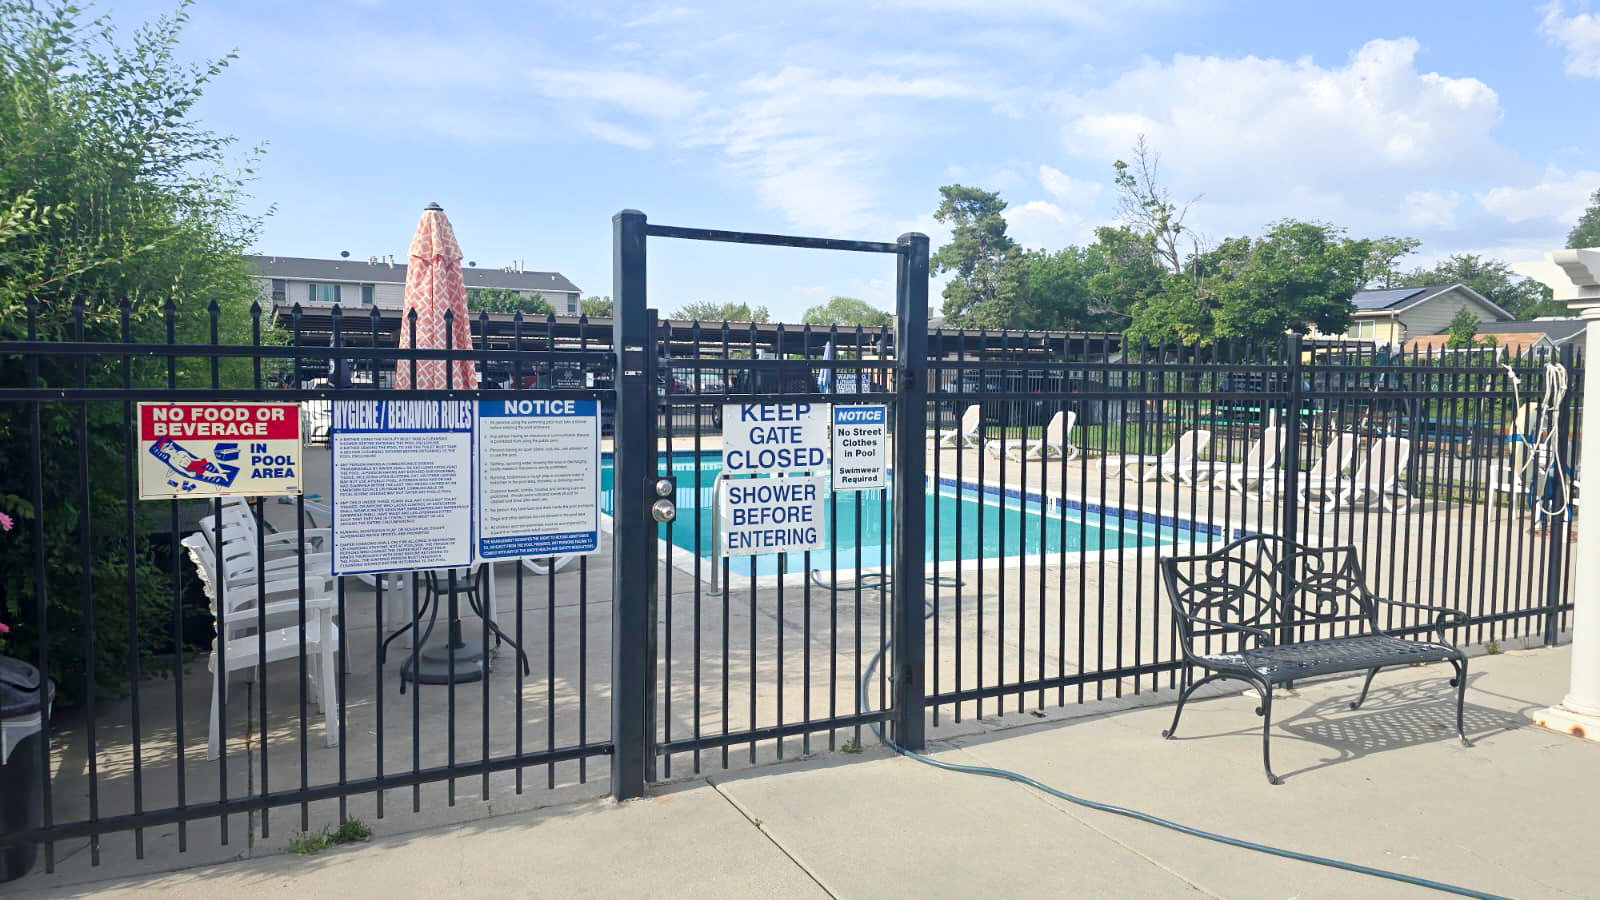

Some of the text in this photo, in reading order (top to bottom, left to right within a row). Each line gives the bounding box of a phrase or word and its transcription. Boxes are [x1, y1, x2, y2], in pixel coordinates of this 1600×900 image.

[152, 407, 285, 421] NO FOOD OR
[334, 400, 472, 429] HYGIENE / BEHAVIOR RULES
[504, 400, 576, 415] NOTICE
[741, 402, 811, 422] KEEP
[838, 410, 882, 421] NOTICE
[153, 422, 268, 436] BEVERAGE
[750, 426, 803, 445] GATE
[838, 428, 882, 437] No Street
[251, 443, 267, 453] IN
[842, 439, 877, 447] Clothes
[726, 447, 825, 470] CLOSED
[844, 449, 876, 457] in Pool
[251, 455, 295, 466] POOL
[251, 468, 295, 479] AREA
[839, 466, 880, 474] Swimwear
[841, 475, 878, 484] Required
[729, 484, 816, 505] SHOWER
[733, 505, 813, 525] BEFORE
[728, 528, 817, 549] ENTERING
